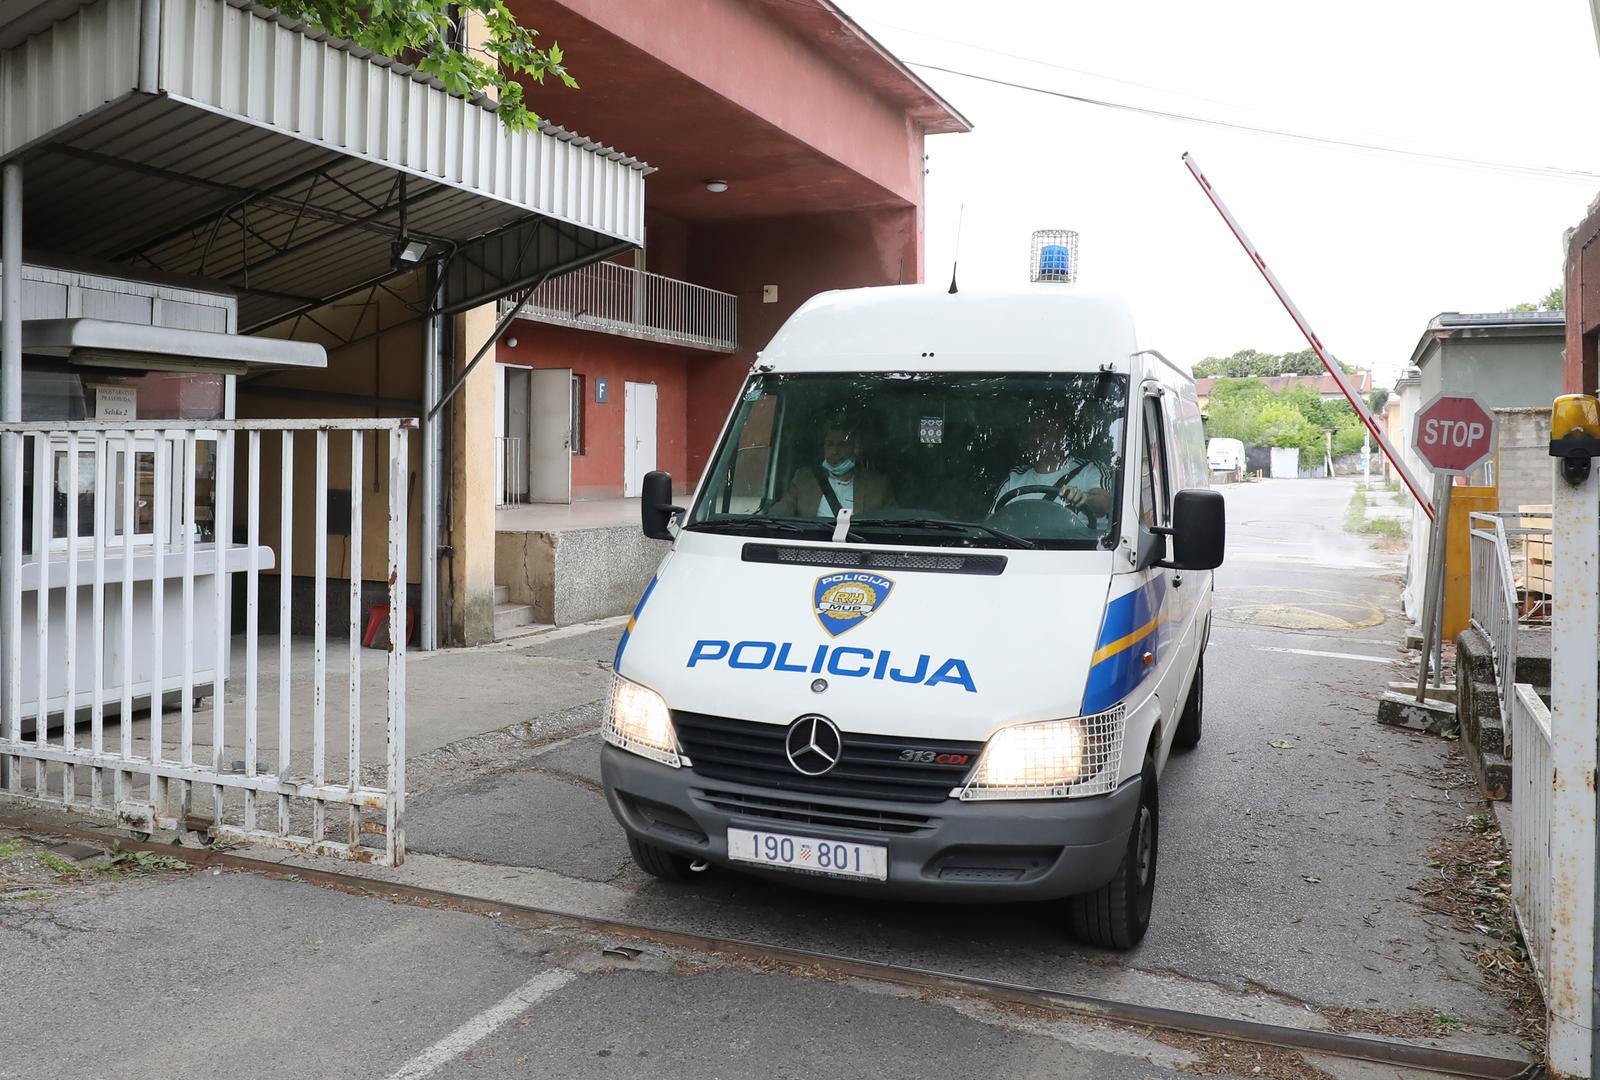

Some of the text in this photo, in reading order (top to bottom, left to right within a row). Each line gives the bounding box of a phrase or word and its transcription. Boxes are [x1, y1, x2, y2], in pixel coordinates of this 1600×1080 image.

[599, 383, 606, 399] F
[1423, 418, 1485, 448] STOP
[821, 574, 891, 589] POLICIJA
[833, 591, 864, 604] RH
[686, 639, 978, 693] POLICIJA
[753, 834, 794, 863] 190
[817, 842, 860, 872] 801
